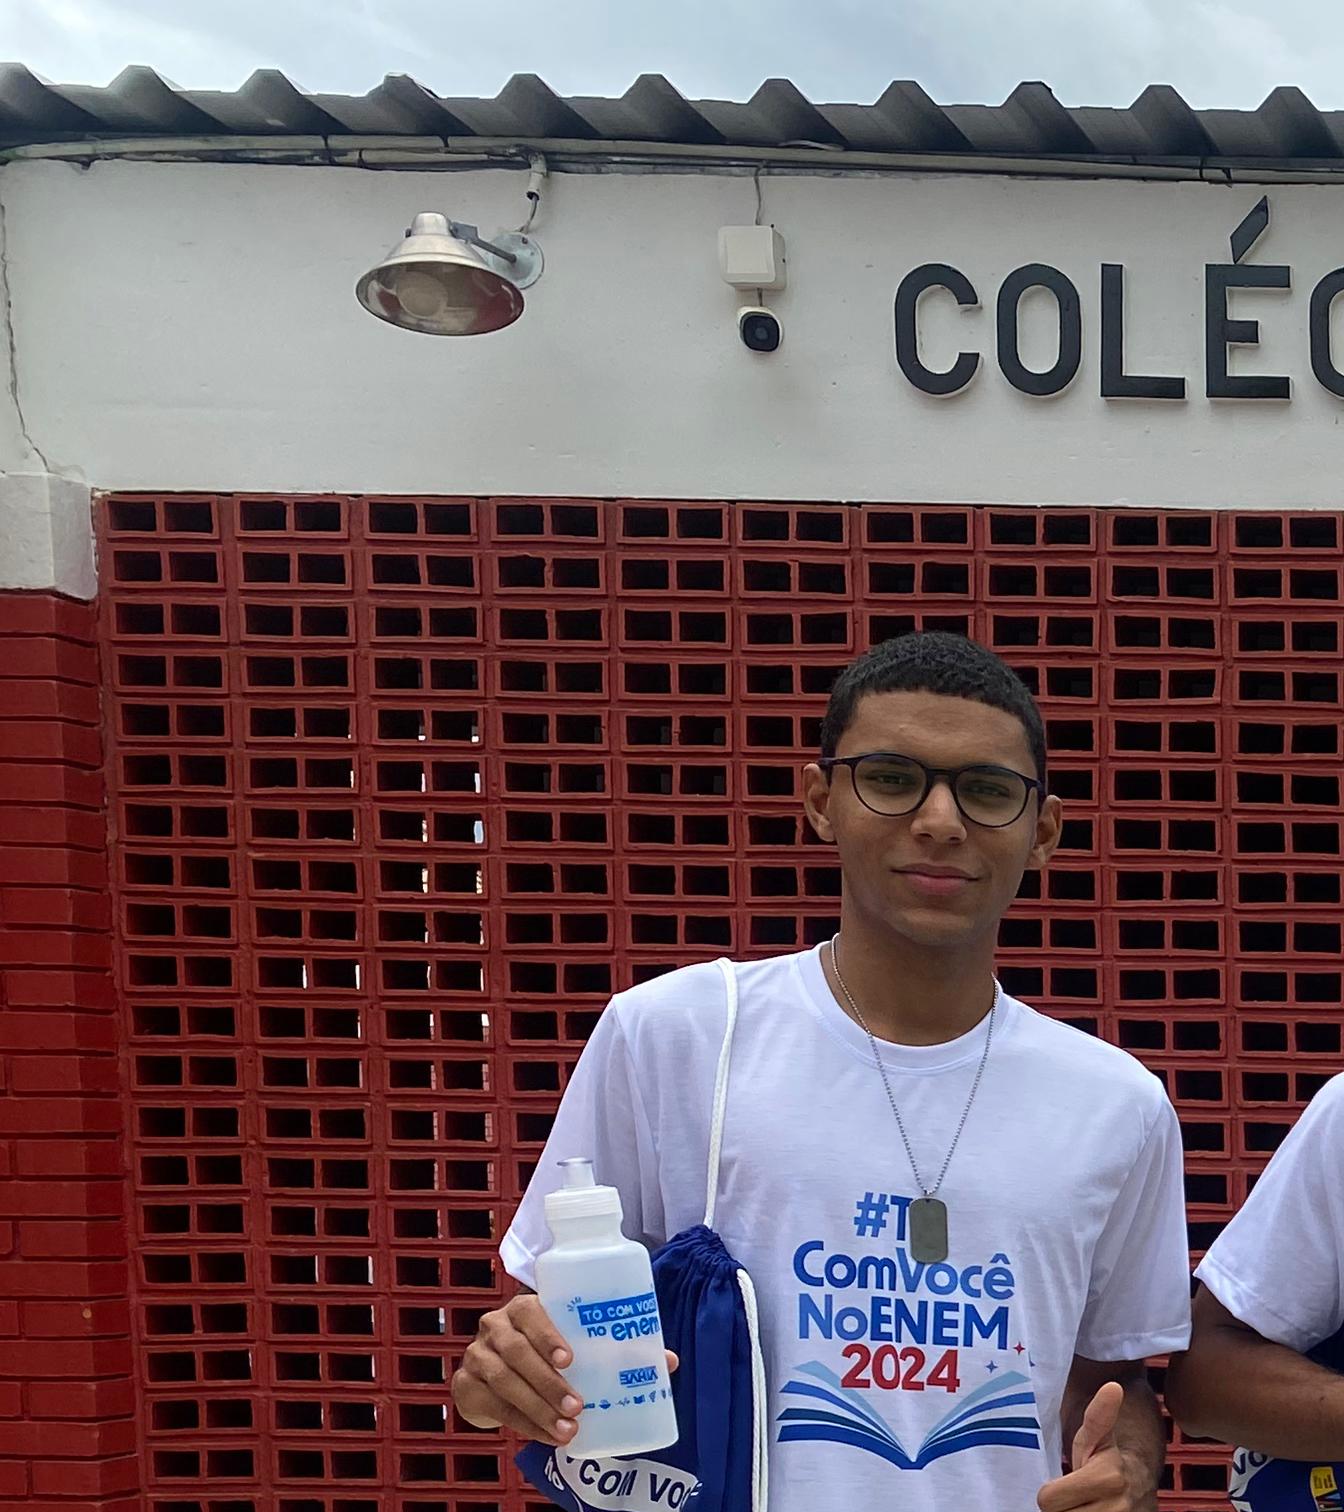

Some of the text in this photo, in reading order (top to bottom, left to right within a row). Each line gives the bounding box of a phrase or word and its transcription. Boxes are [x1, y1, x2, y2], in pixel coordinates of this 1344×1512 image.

[853, 1191, 913, 1241] #T
[793, 1240, 1015, 1300] ComVocê
[587, 1325, 607, 1338] no
[798, 1293, 1009, 1350] NoENEM
[840, 1343, 961, 1393] 2024
[650, 1472, 692, 1510] VO
